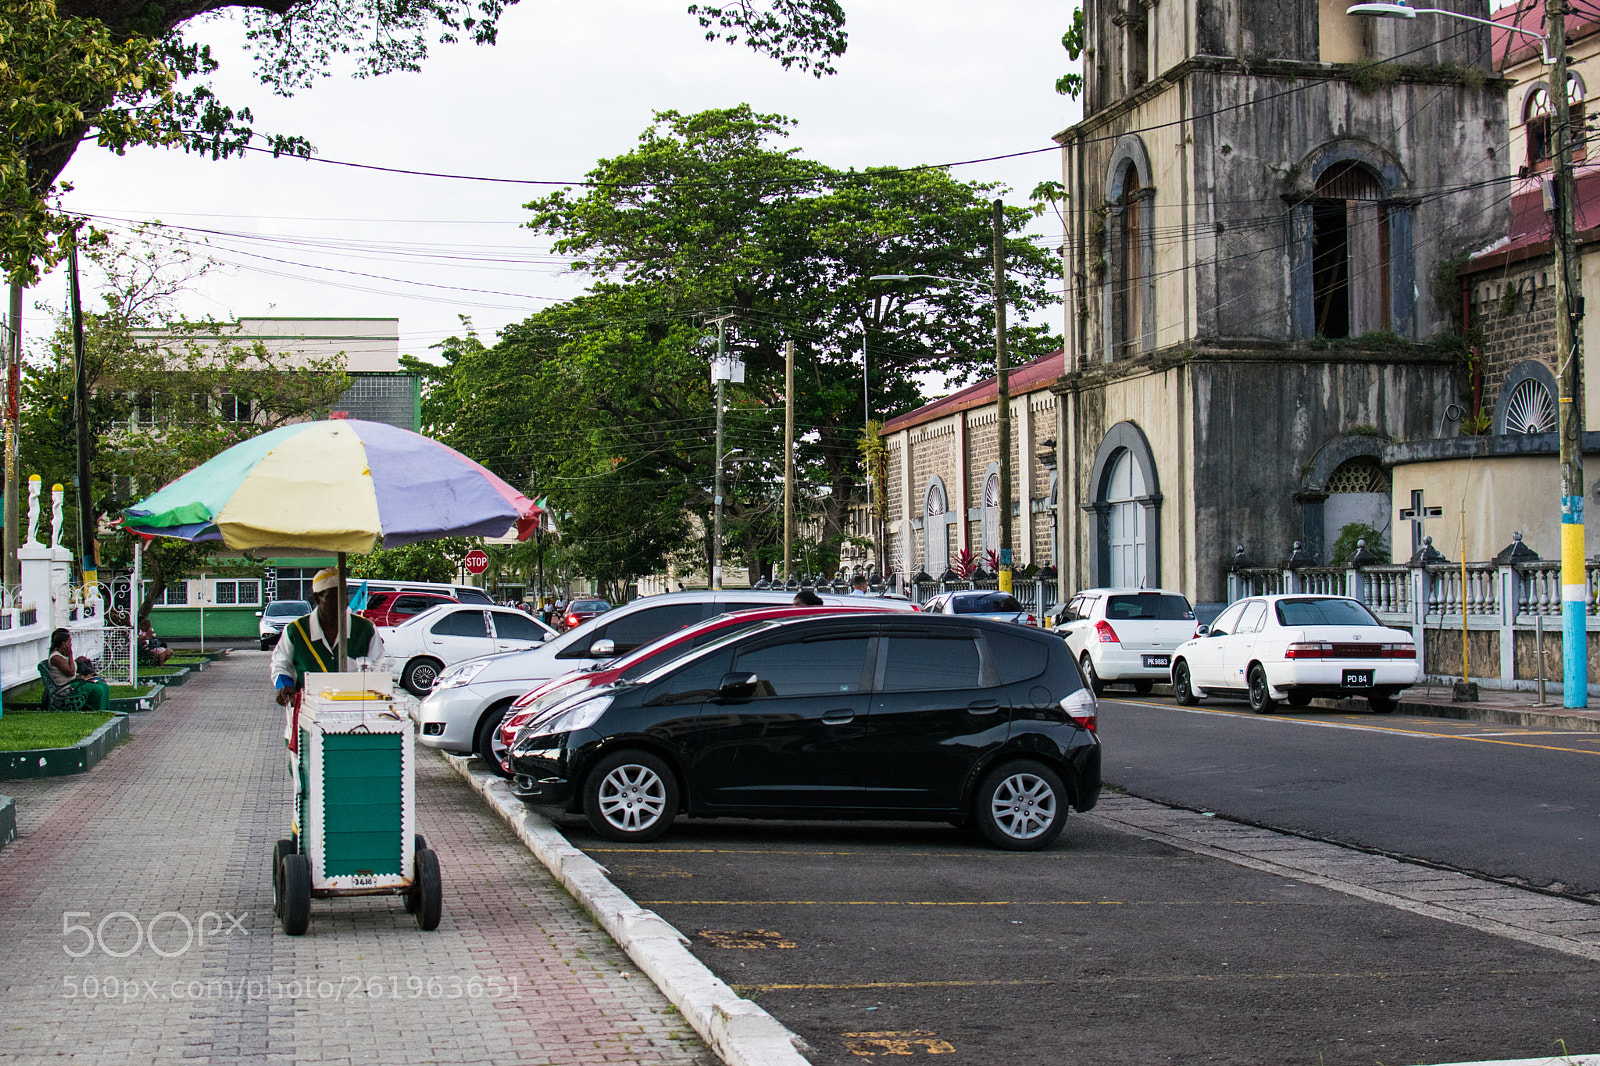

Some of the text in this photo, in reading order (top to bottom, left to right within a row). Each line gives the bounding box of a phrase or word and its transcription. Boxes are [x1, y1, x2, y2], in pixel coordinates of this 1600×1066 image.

[466, 557, 487, 567] STOP
[1347, 675, 1367, 683] PD 84
